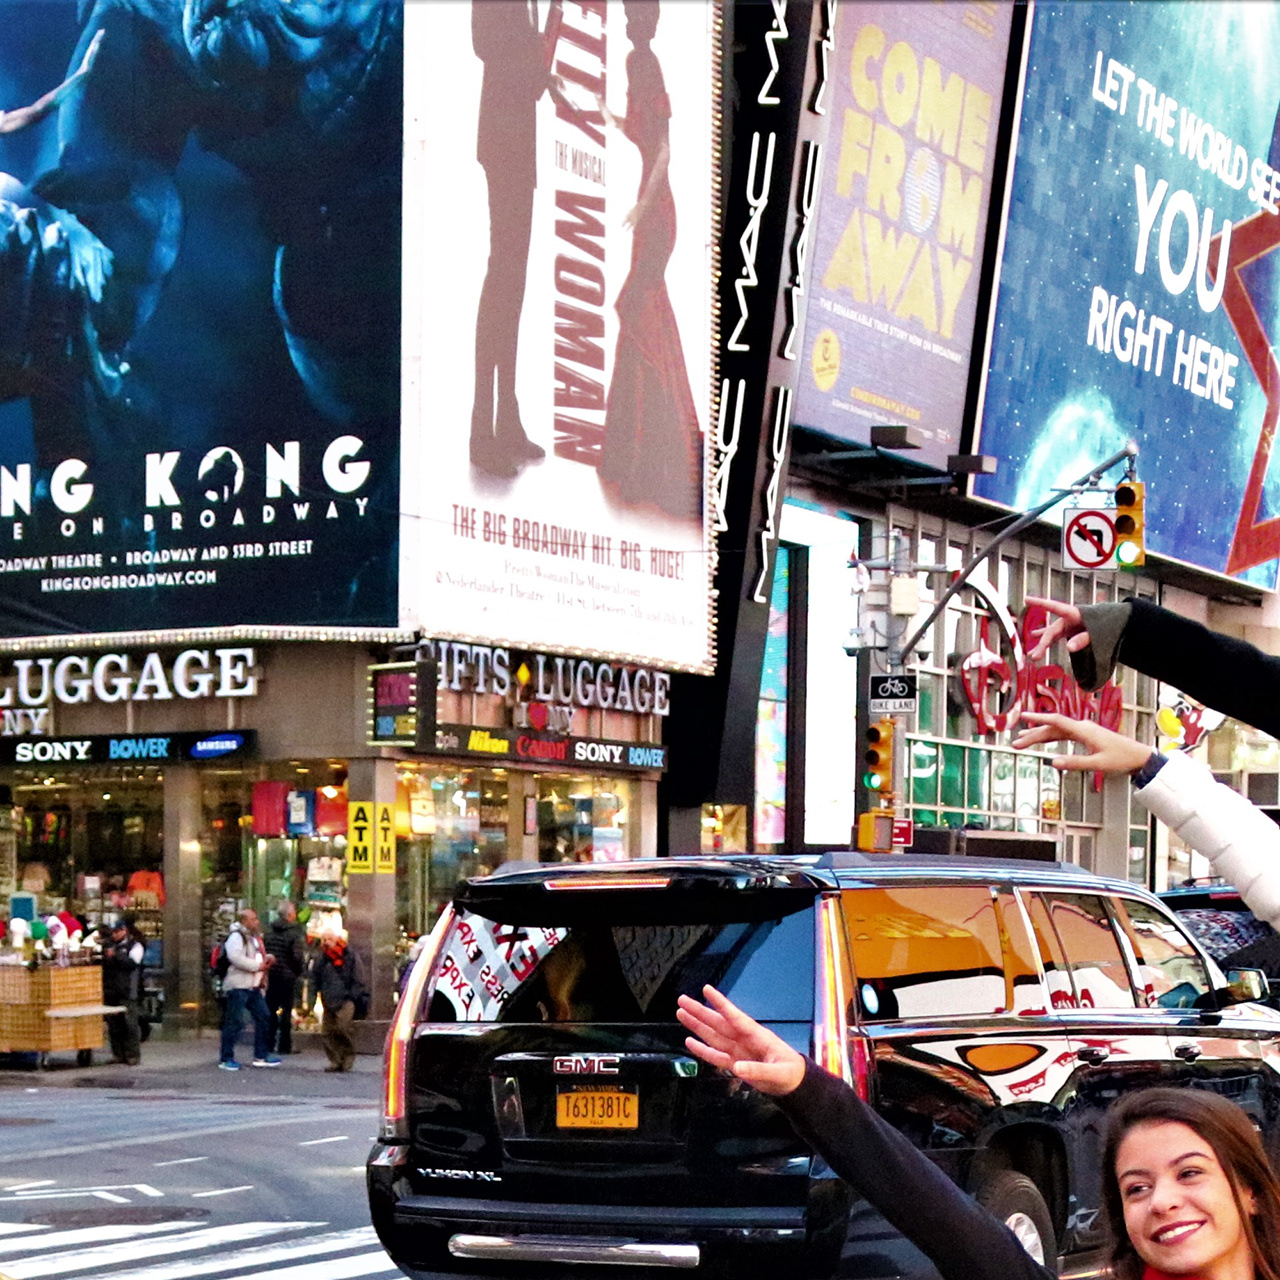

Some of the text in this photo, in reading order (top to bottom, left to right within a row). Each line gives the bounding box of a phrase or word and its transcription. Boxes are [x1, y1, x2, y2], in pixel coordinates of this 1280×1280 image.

[850, 23, 993, 173] COME
[1092, 51, 1135, 115] LET
[1137, 77, 1178, 147] THE
[1179, 107, 1248, 190] WORLD
[555, 139, 606, 187] THE MUSICAL
[835, 107, 983, 259] FROM
[1134, 163, 1233, 313] YOU
[822, 207, 973, 340] AWAY
[553, 188, 608, 468] WOMAN
[1087, 286, 1239, 410] RIGHT HERE
[145, 435, 371, 507] KONG
[61, 517, 104, 538] ON
[143, 497, 369, 532] BROADWAY
[452, 503, 685, 581] THE BIG BROADWAY HIT. BIG. HUGE!
[41, 570, 216, 592] KINGKONGBROADWAY.COM
[51, 554, 102, 570] THEATRE
[125, 547, 198, 566] BROADWAY
[201, 545, 229, 560] AND
[233, 543, 264, 559] 53RD
[269, 540, 313, 556] STREET
[536, 654, 670, 716] LUGGAGE
[872, 700, 914, 710] BIKE LANE
[15, 741, 92, 762] SONY
[109, 737, 169, 760] BOWER
[196, 740, 238, 751] SAMSUNG
[468, 730, 509, 753] Nikon
[516, 735, 567, 760] Canon
[575, 742, 623, 763] SONY
[628, 746, 665, 767] BOWER
[353, 806, 369, 862] ATM
[380, 807, 391, 862] ATM
[553, 1056, 621, 1074] GMC
[565, 1095, 631, 1119] T631381C
[417, 1168, 502, 1181] YUKON XL
